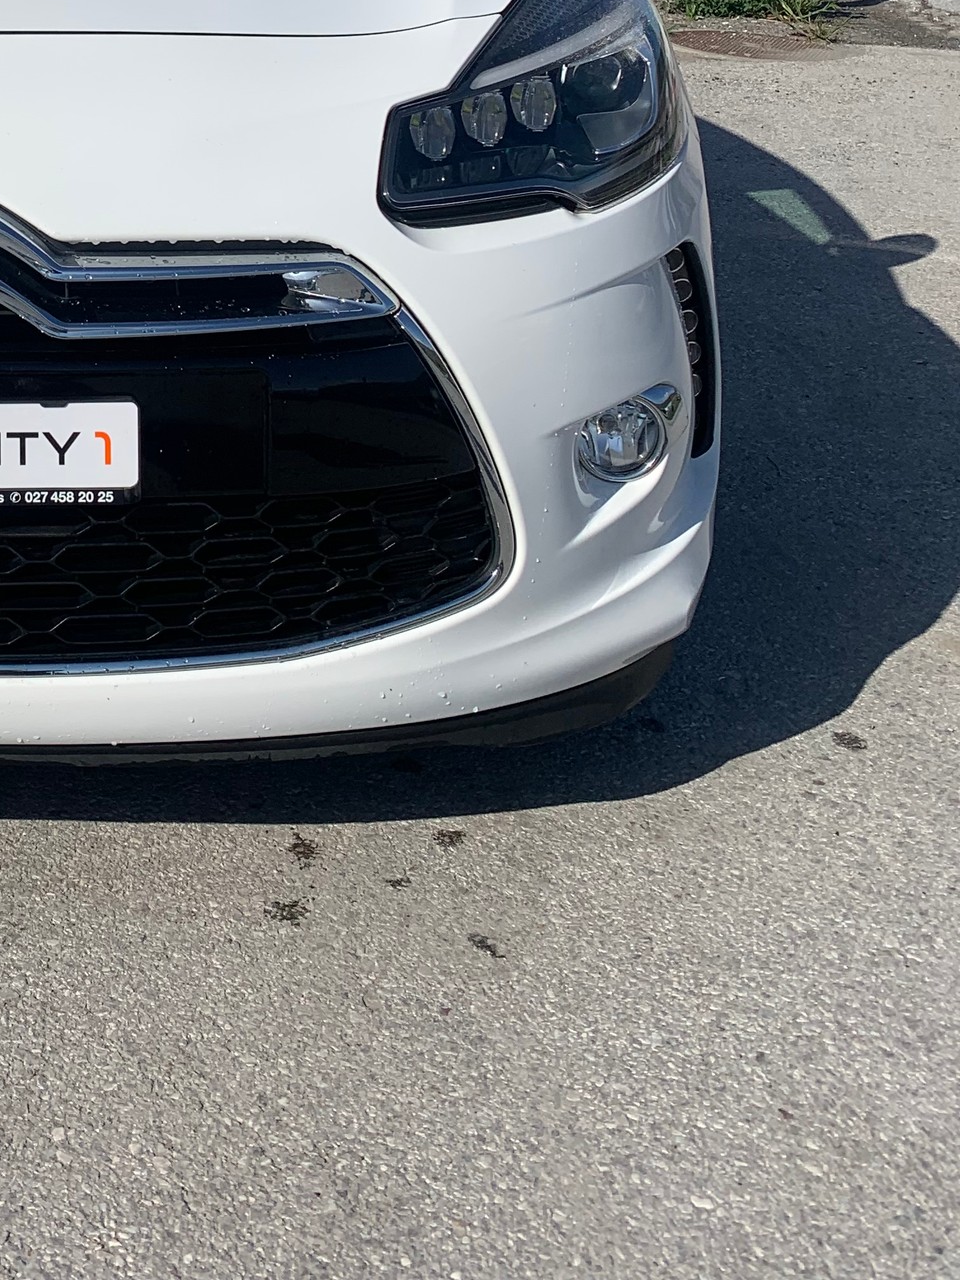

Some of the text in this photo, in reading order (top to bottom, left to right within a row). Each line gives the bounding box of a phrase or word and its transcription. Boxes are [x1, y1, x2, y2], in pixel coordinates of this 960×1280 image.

[24, 491, 49, 503] 027
[50, 491, 75, 503] 458
[77, 491, 96, 503] 20
[97, 491, 115, 503] 25
